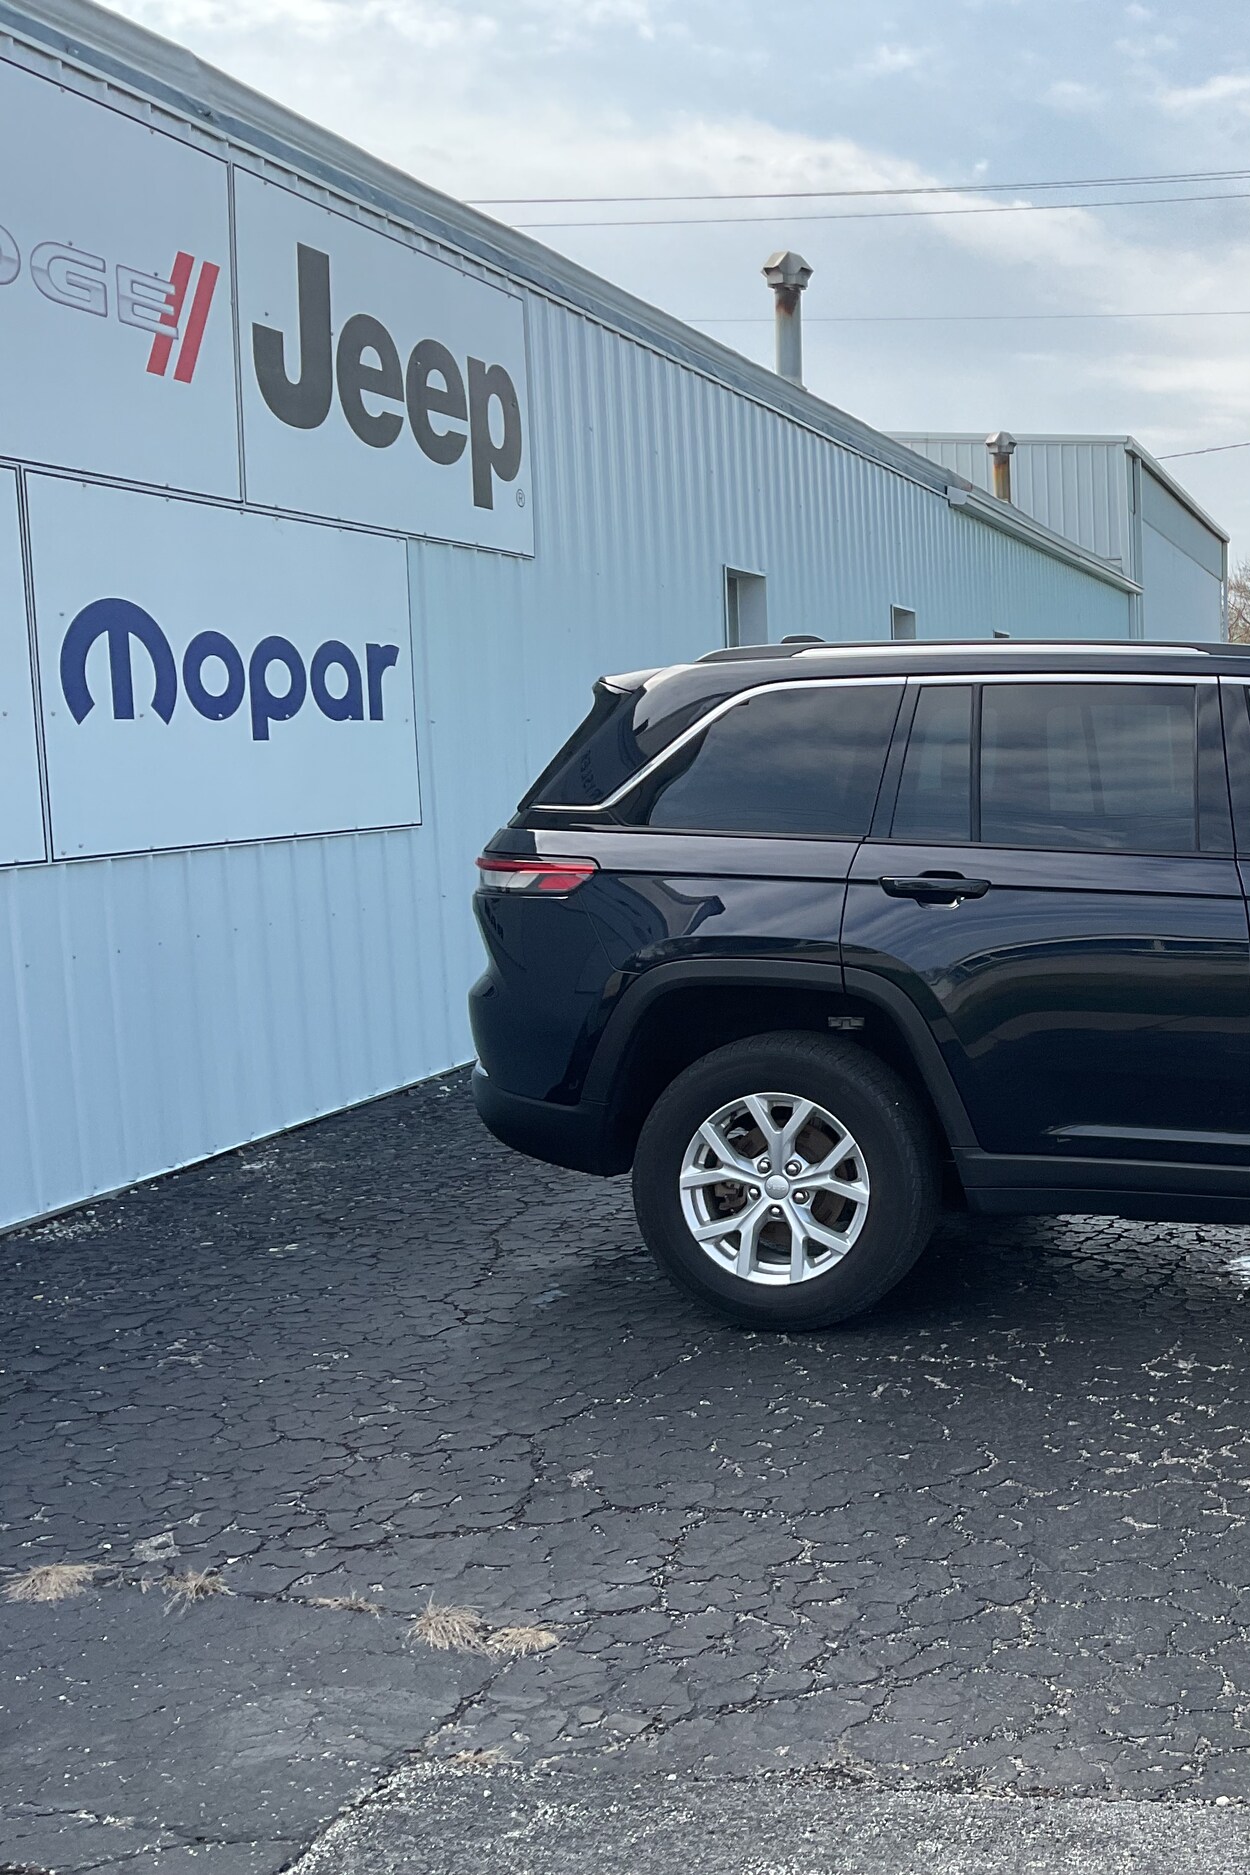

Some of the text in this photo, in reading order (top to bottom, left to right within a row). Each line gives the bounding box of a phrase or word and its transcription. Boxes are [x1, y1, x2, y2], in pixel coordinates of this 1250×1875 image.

[0, 225, 179, 341] GE
[252, 242, 522, 510] Jeep
[60, 597, 399, 740] Mopar
